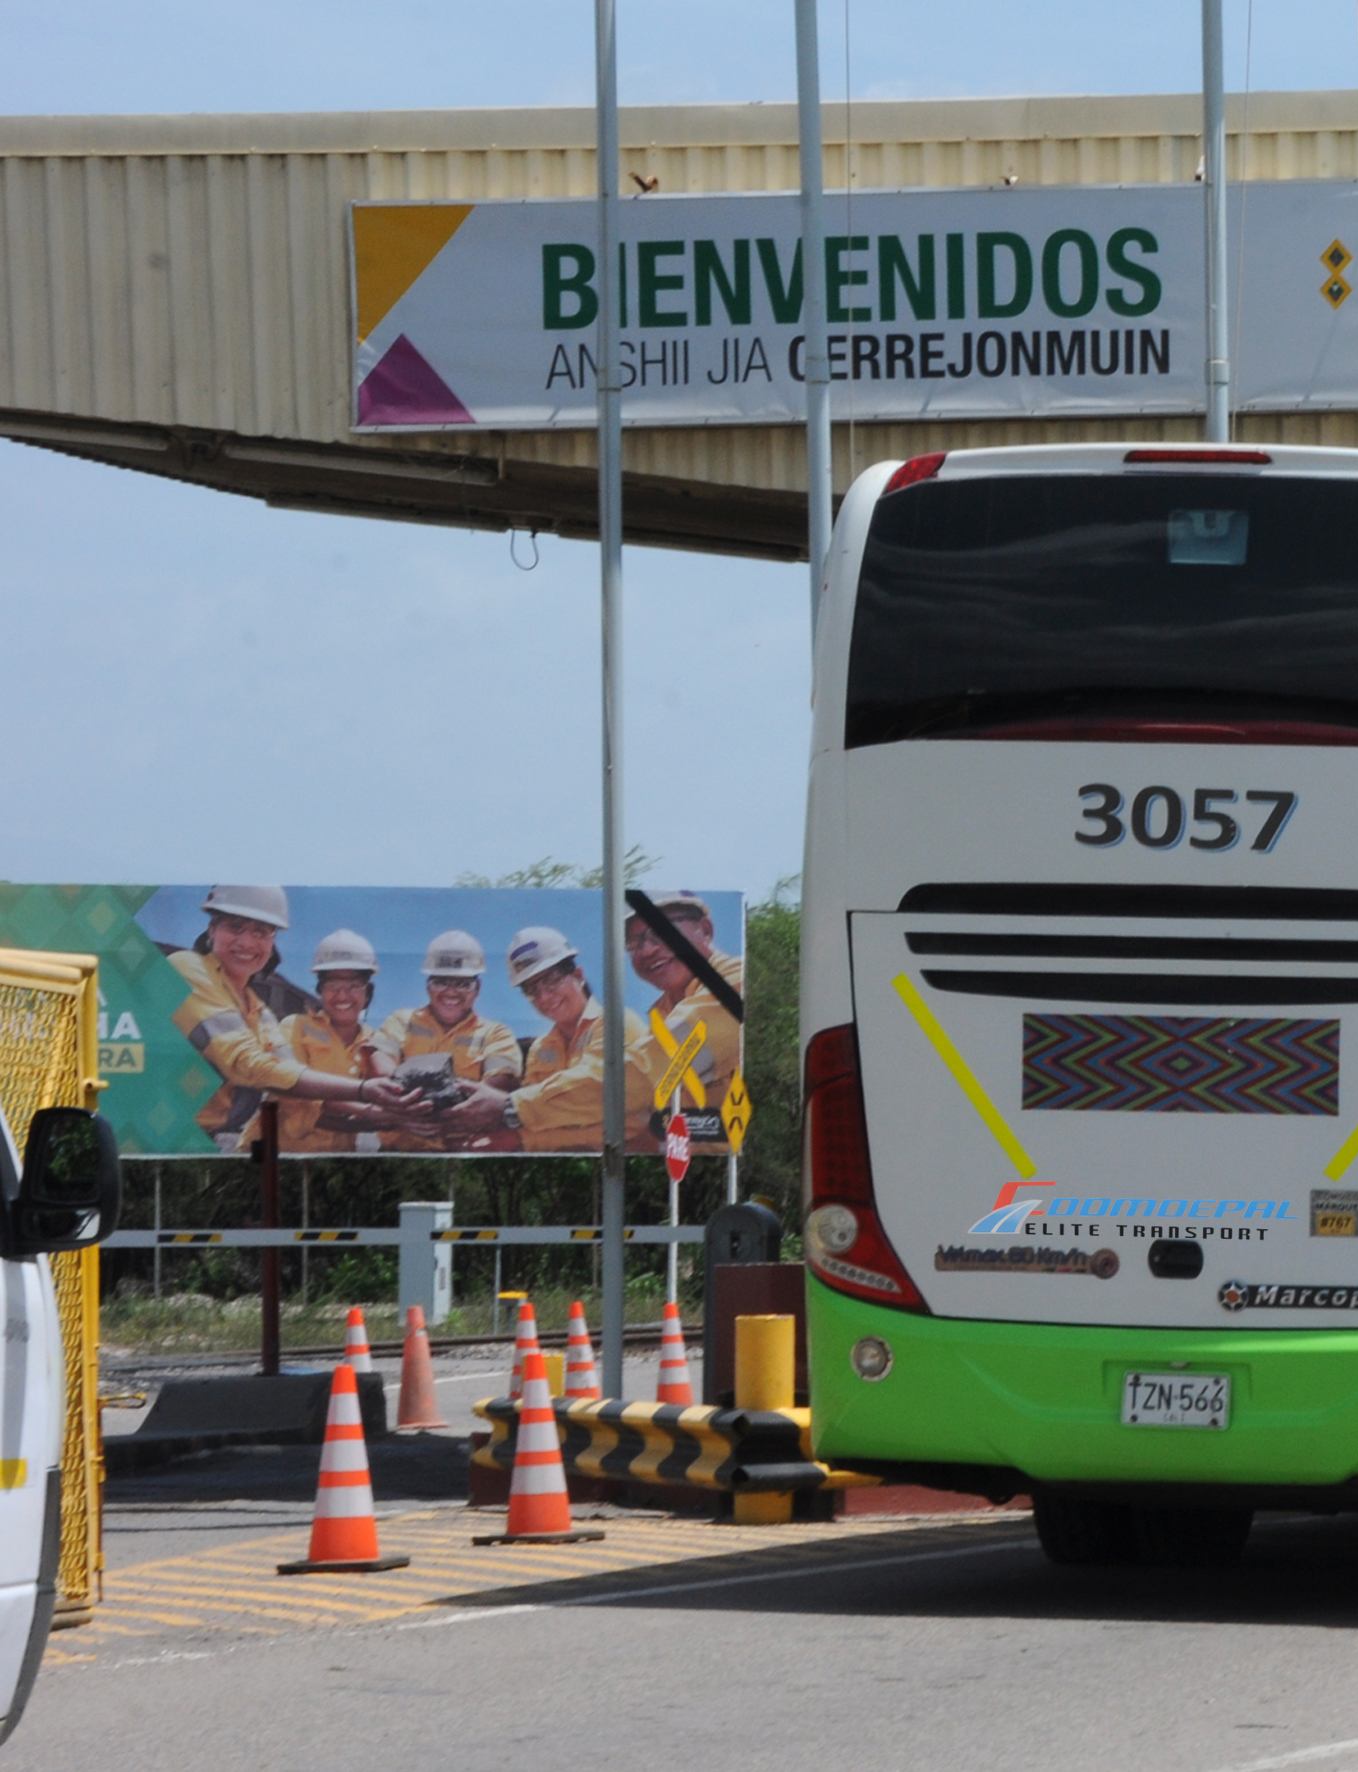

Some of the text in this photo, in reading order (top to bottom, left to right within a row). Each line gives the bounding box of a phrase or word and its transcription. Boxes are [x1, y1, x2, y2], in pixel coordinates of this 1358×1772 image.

[546, 329, 1170, 389] ANSHII JIA CERREJONMUIN
[1075, 783, 1297, 853] 3057
[1025, 1222, 1269, 1241] ELITE TRANSPORT
